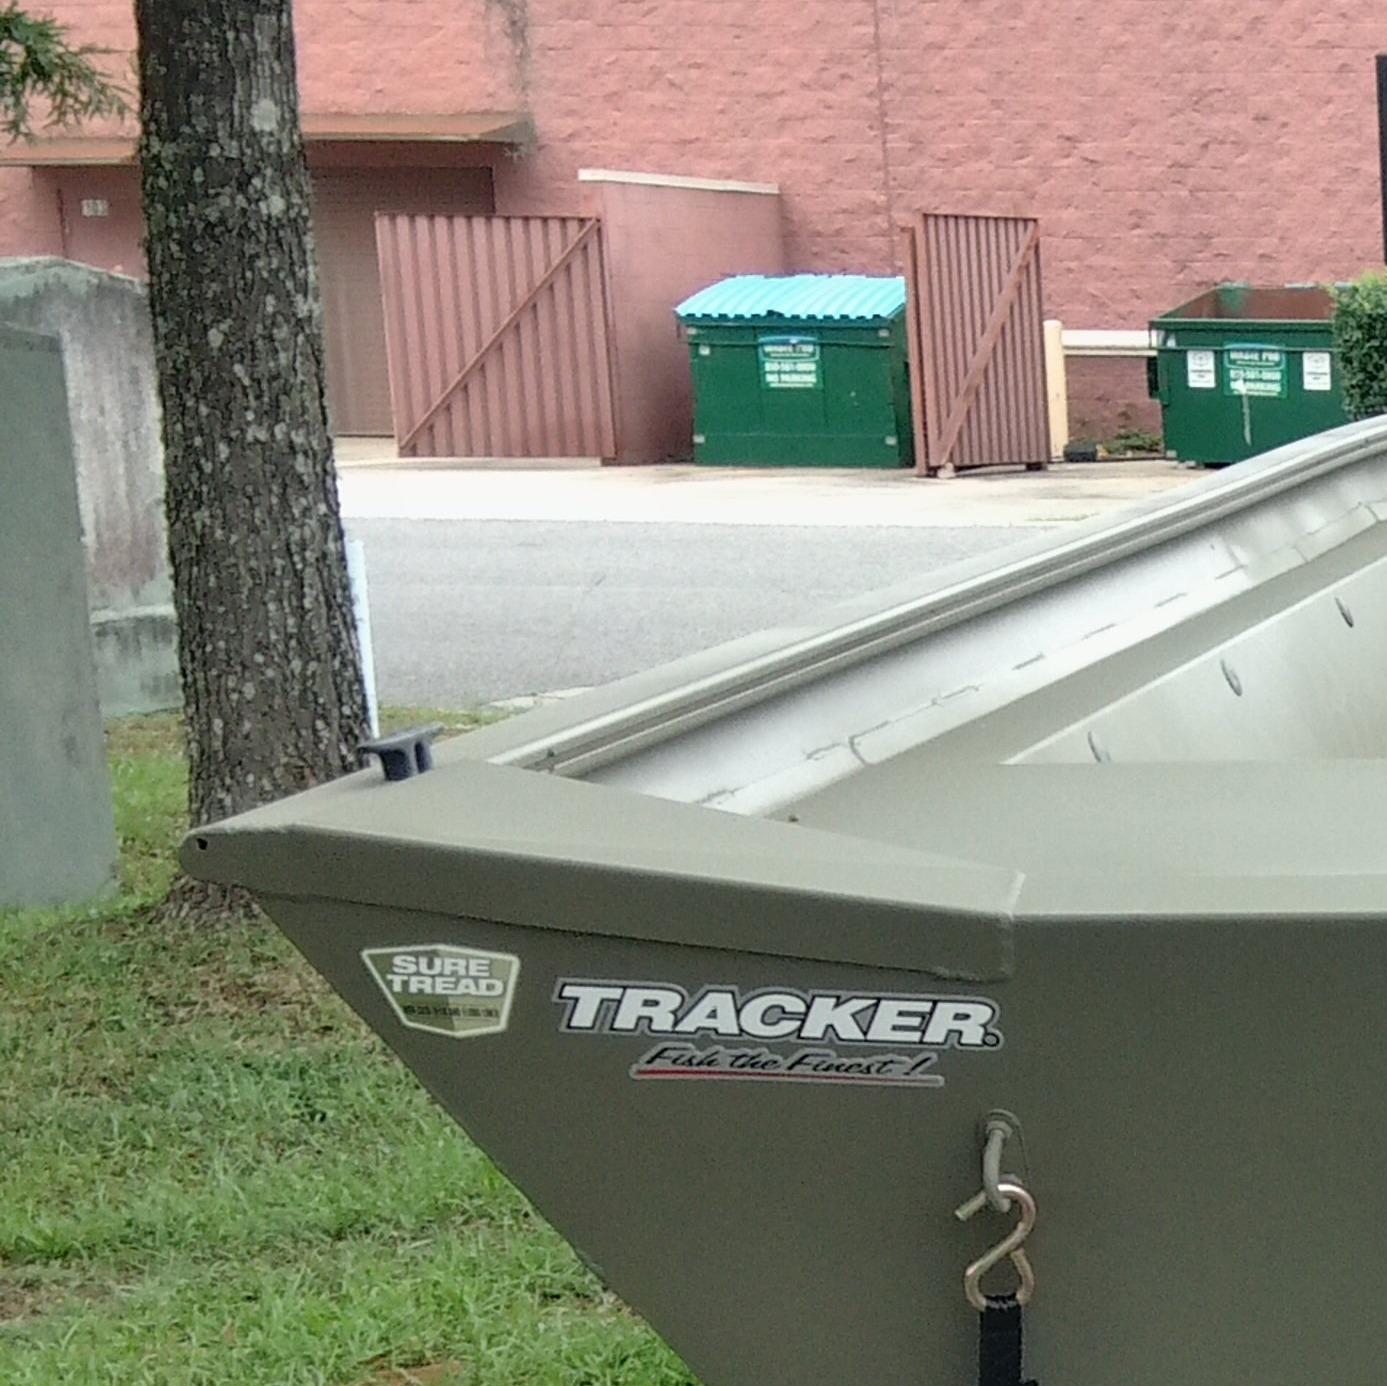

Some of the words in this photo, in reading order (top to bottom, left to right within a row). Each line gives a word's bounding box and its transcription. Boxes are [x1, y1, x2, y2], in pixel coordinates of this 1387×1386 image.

[392, 954, 491, 977] SURE
[386, 974, 504, 996] TREAD
[559, 983, 1000, 1046] TRACKER
[645, 1046, 721, 1068] Fish
[728, 1049, 783, 1071] the
